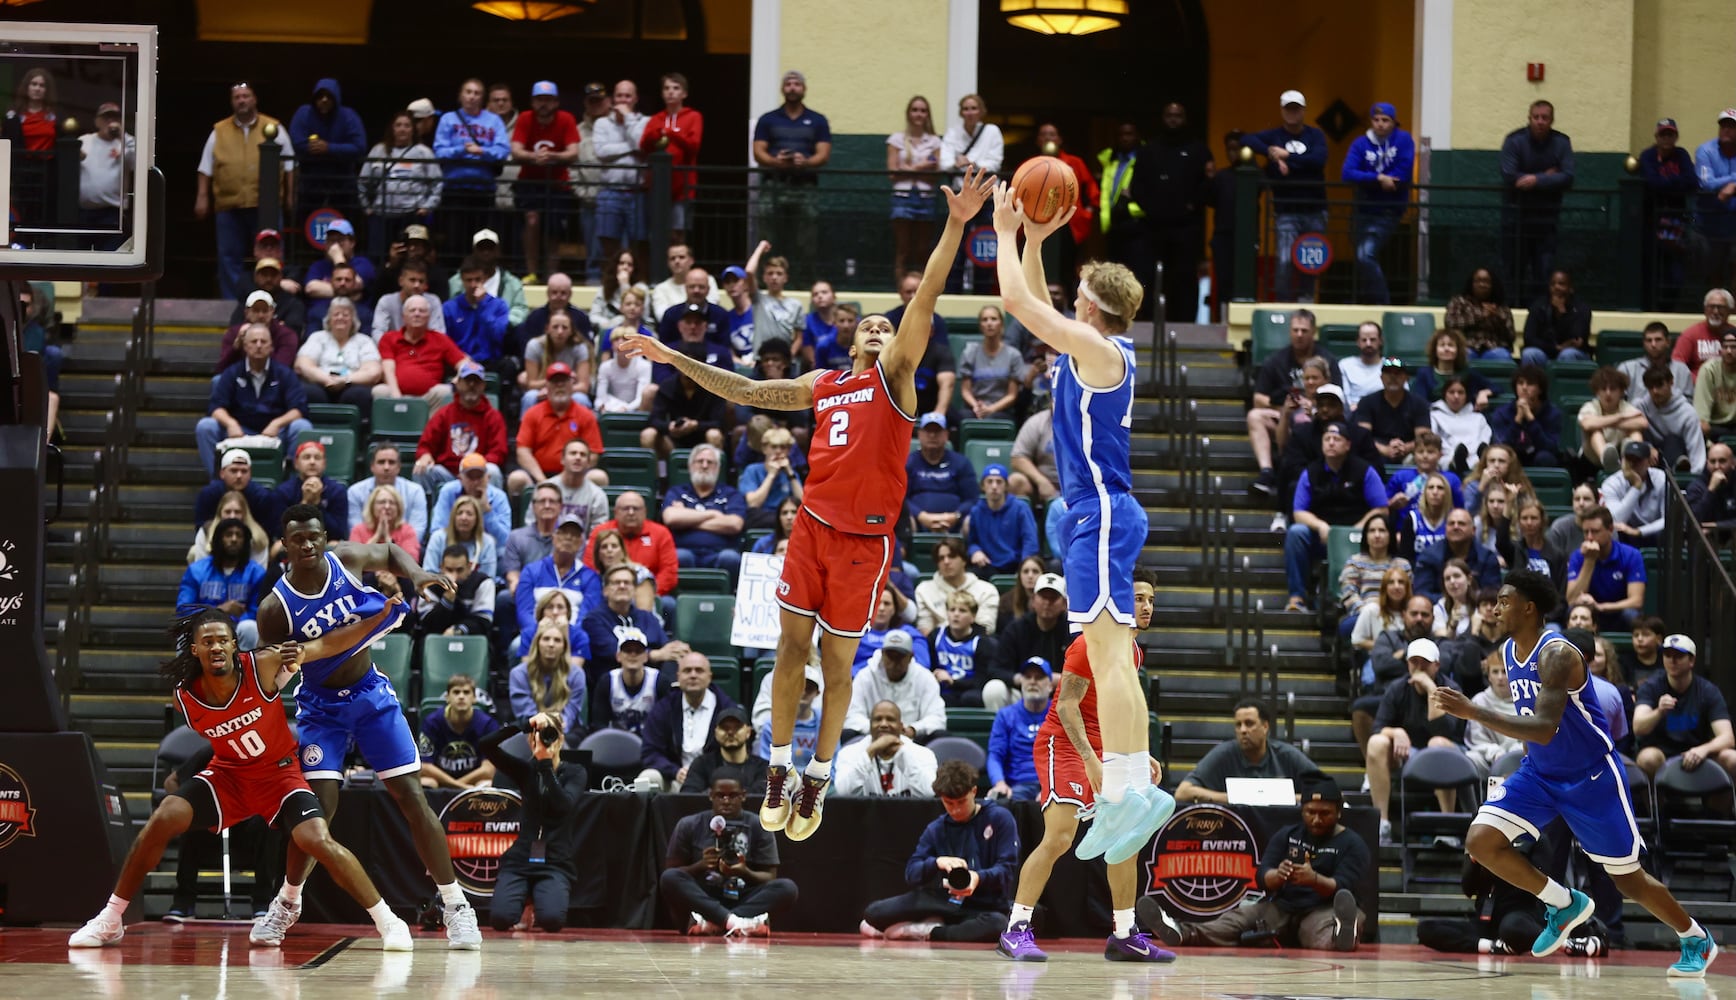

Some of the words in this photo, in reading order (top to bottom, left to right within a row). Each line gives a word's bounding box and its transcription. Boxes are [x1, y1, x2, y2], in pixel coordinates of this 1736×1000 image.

[976, 241, 997, 257] 119
[1301, 247, 1324, 264] 120
[744, 387, 796, 403] SACRIFICE
[817, 387, 875, 412] DAYTON
[828, 410, 850, 447] 2
[2, 539, 16, 551] IT
[204, 706, 263, 738] DAYTON
[227, 729, 266, 760] 10
[447, 821, 482, 832] ESPN
[1166, 840, 1200, 850] ESPN
[1202, 840, 1246, 850] EVENTS
[1162, 854, 1248, 876] INVITATIONAL
